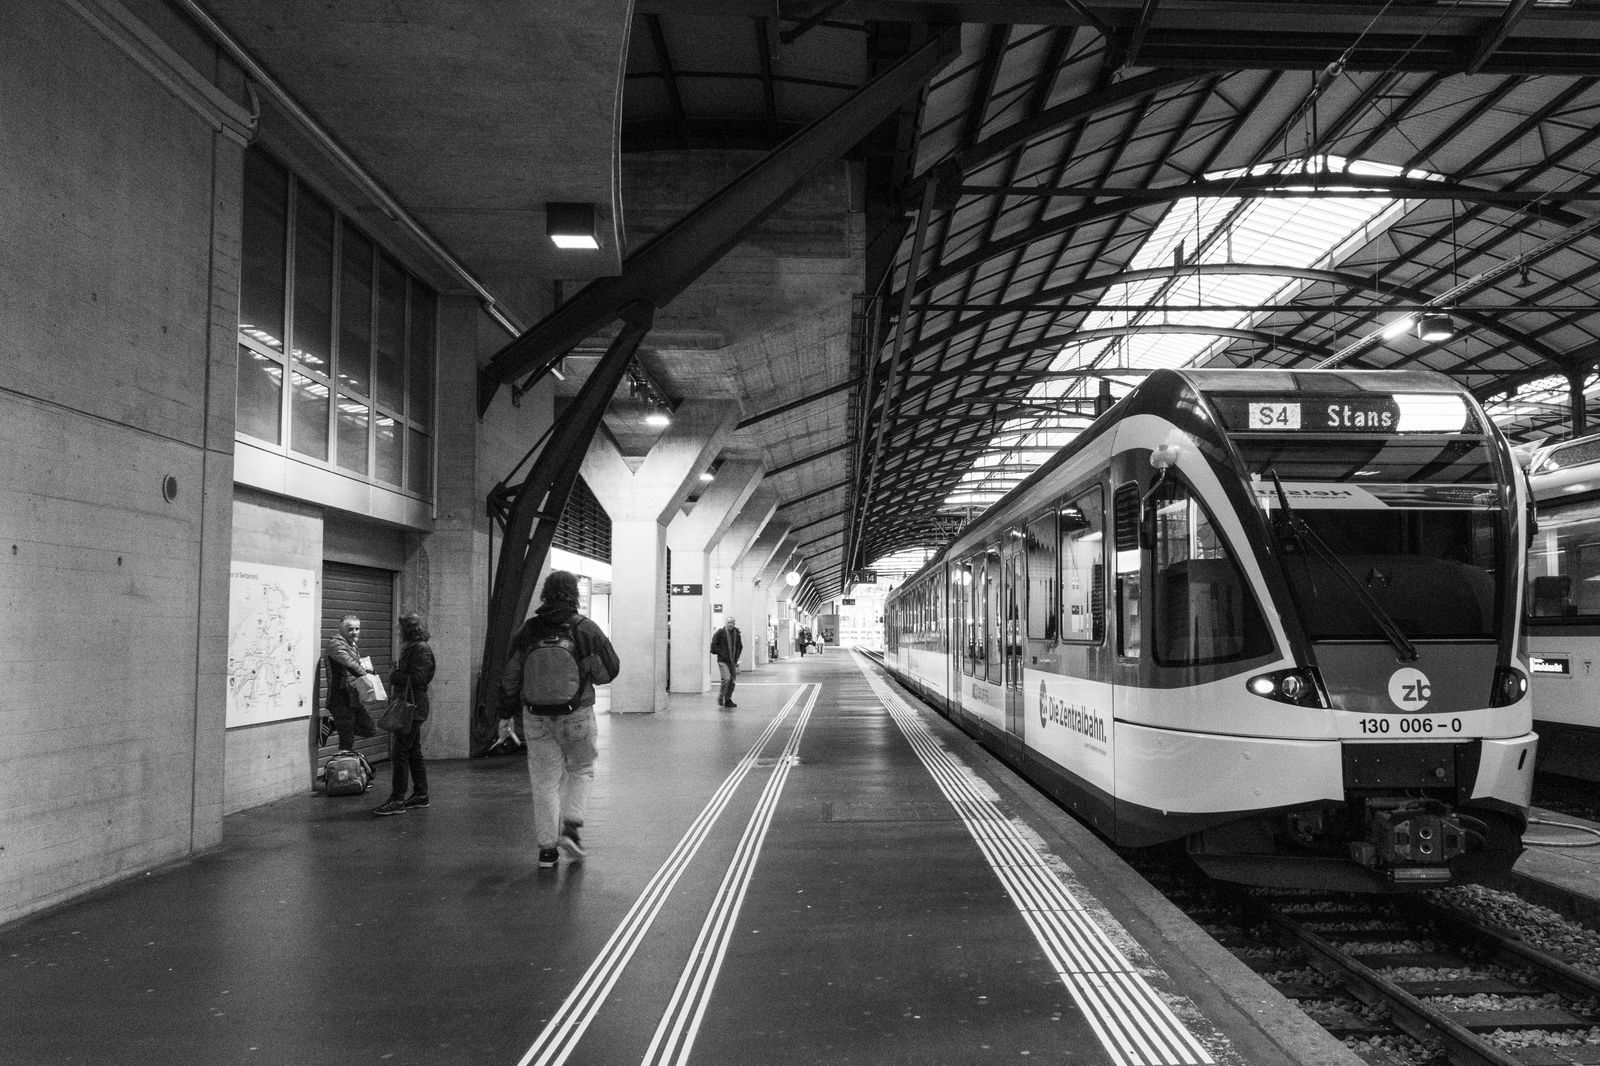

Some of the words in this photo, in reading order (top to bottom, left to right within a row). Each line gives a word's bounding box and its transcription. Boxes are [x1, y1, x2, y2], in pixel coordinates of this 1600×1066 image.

[1259, 406, 1289, 426] S4
[1327, 404, 1393, 427] Stans
[853, 574, 860, 582] A
[865, 574, 875, 582] 14
[1401, 679, 1432, 702] zb
[1049, 696, 1059, 725] Die
[1059, 699, 1107, 744] Zentralbahn.
[1359, 718, 1390, 734] 130
